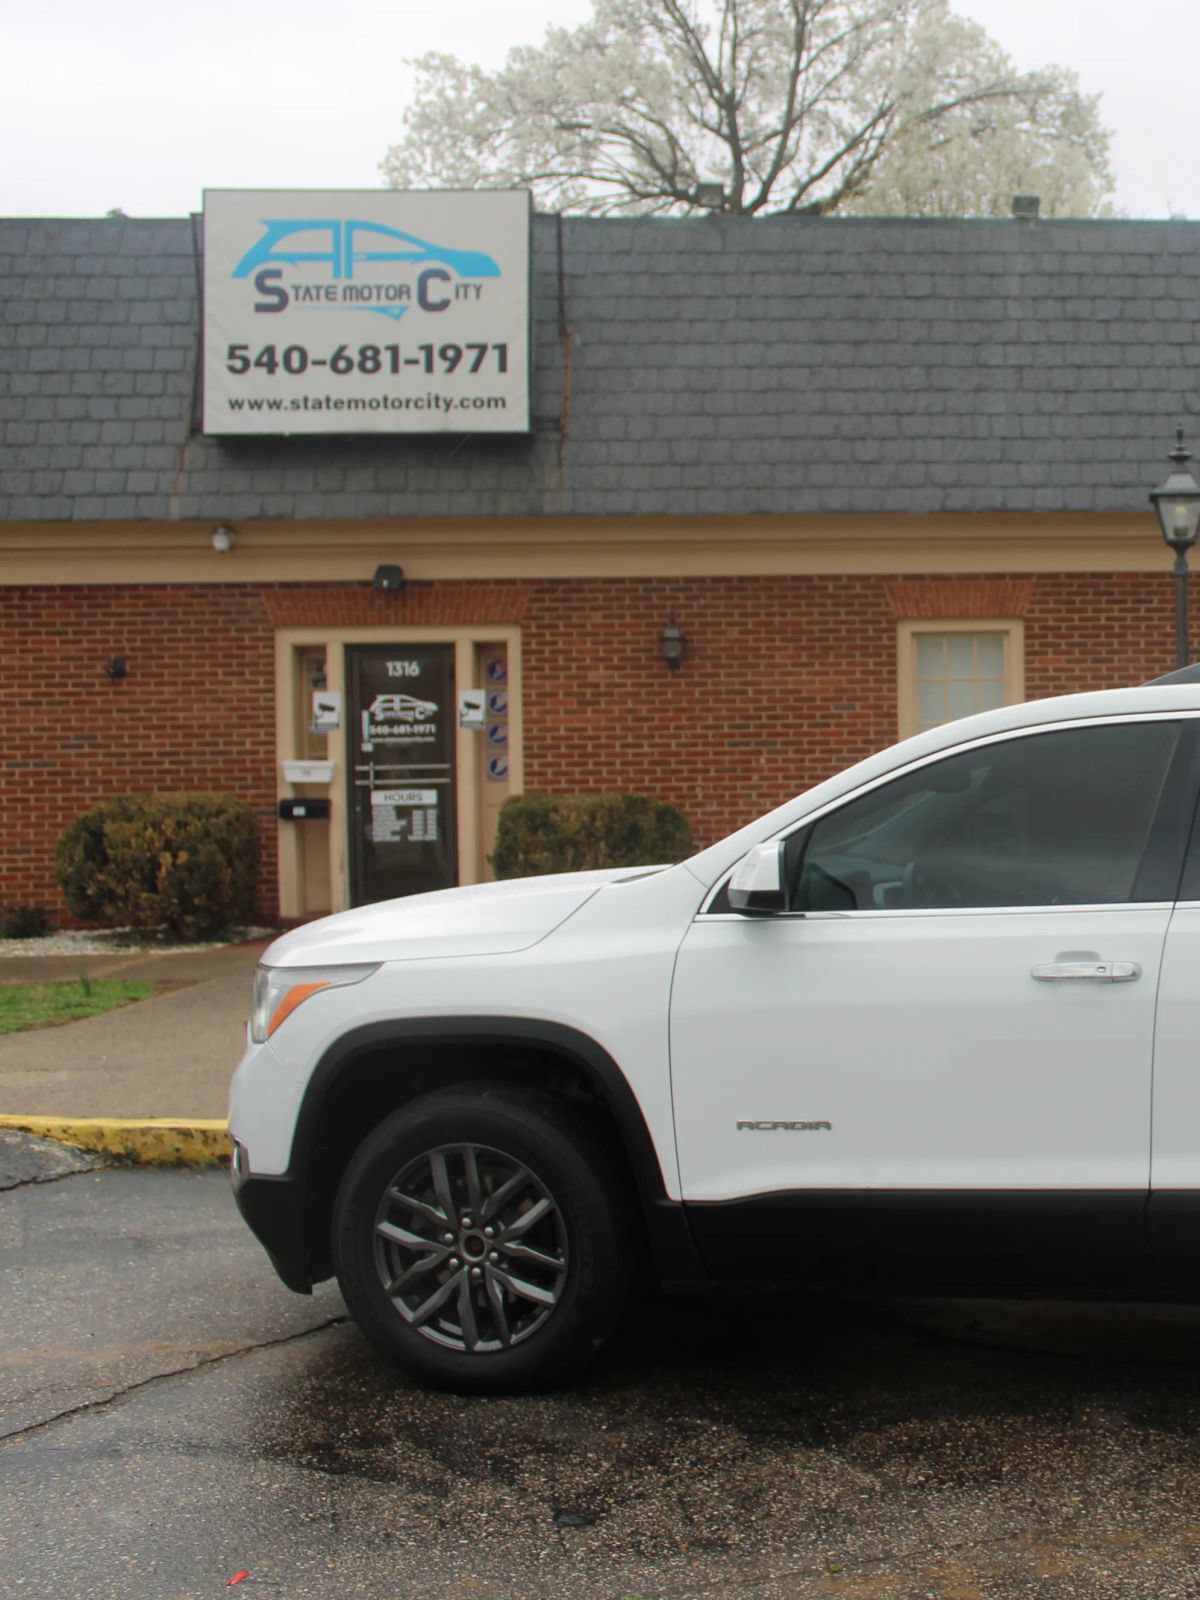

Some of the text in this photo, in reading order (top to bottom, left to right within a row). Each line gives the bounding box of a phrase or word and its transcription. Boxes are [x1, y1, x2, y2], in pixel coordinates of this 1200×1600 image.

[417, 268, 484, 313] CITY
[226, 343, 509, 376] 540-681-1971
[228, 393, 507, 414] www.statemotorcity.com
[385, 660, 421, 677] 1316
[384, 791, 423, 802] HOURS
[736, 1119, 833, 1131] ACADIA
